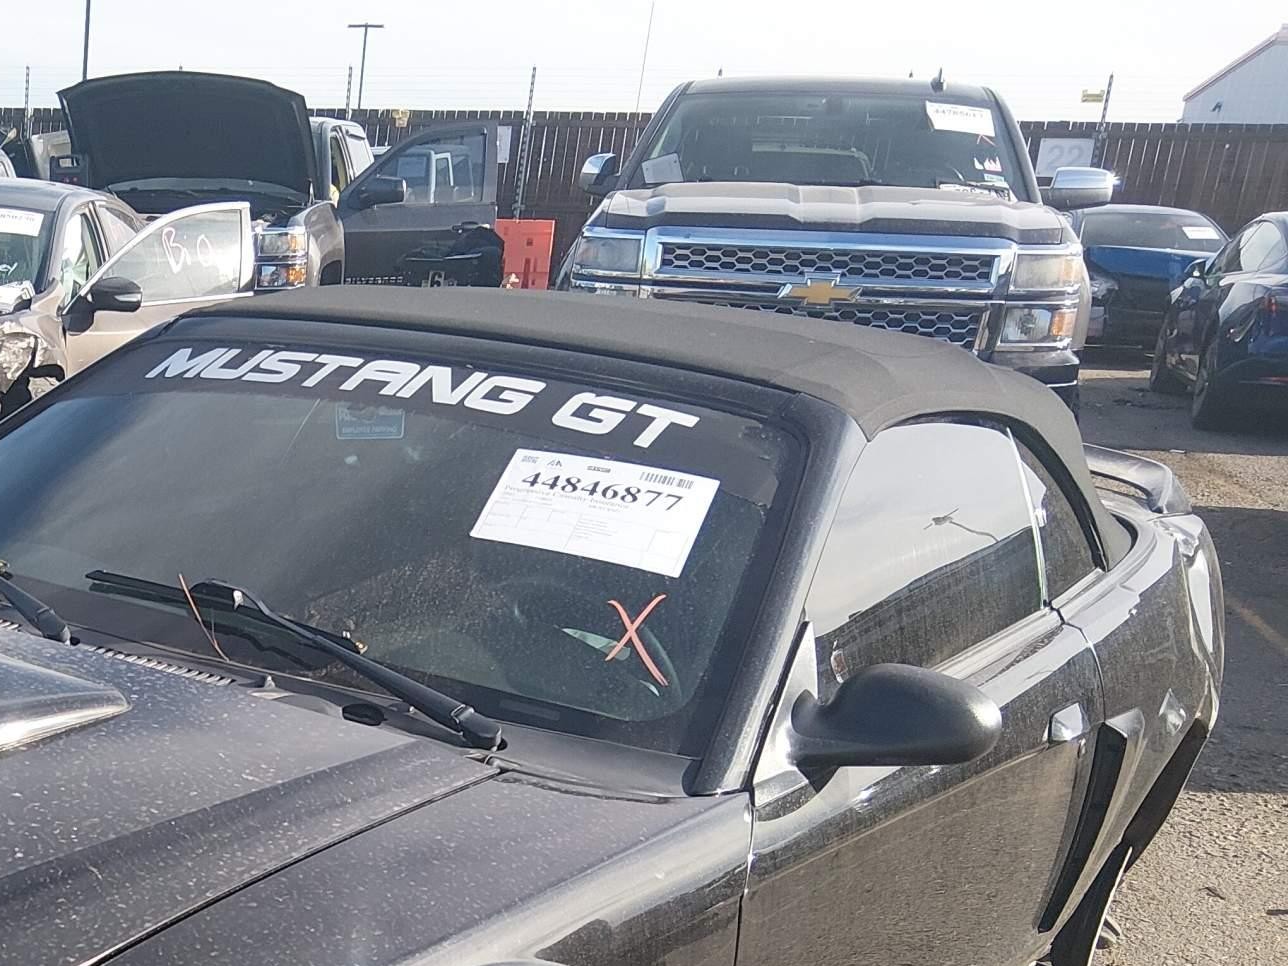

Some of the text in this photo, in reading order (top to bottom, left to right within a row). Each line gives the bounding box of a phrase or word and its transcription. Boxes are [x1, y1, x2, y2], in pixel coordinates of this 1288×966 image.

[144, 346, 701, 449] MUSTANG GT
[521, 471, 684, 512] 44846877
